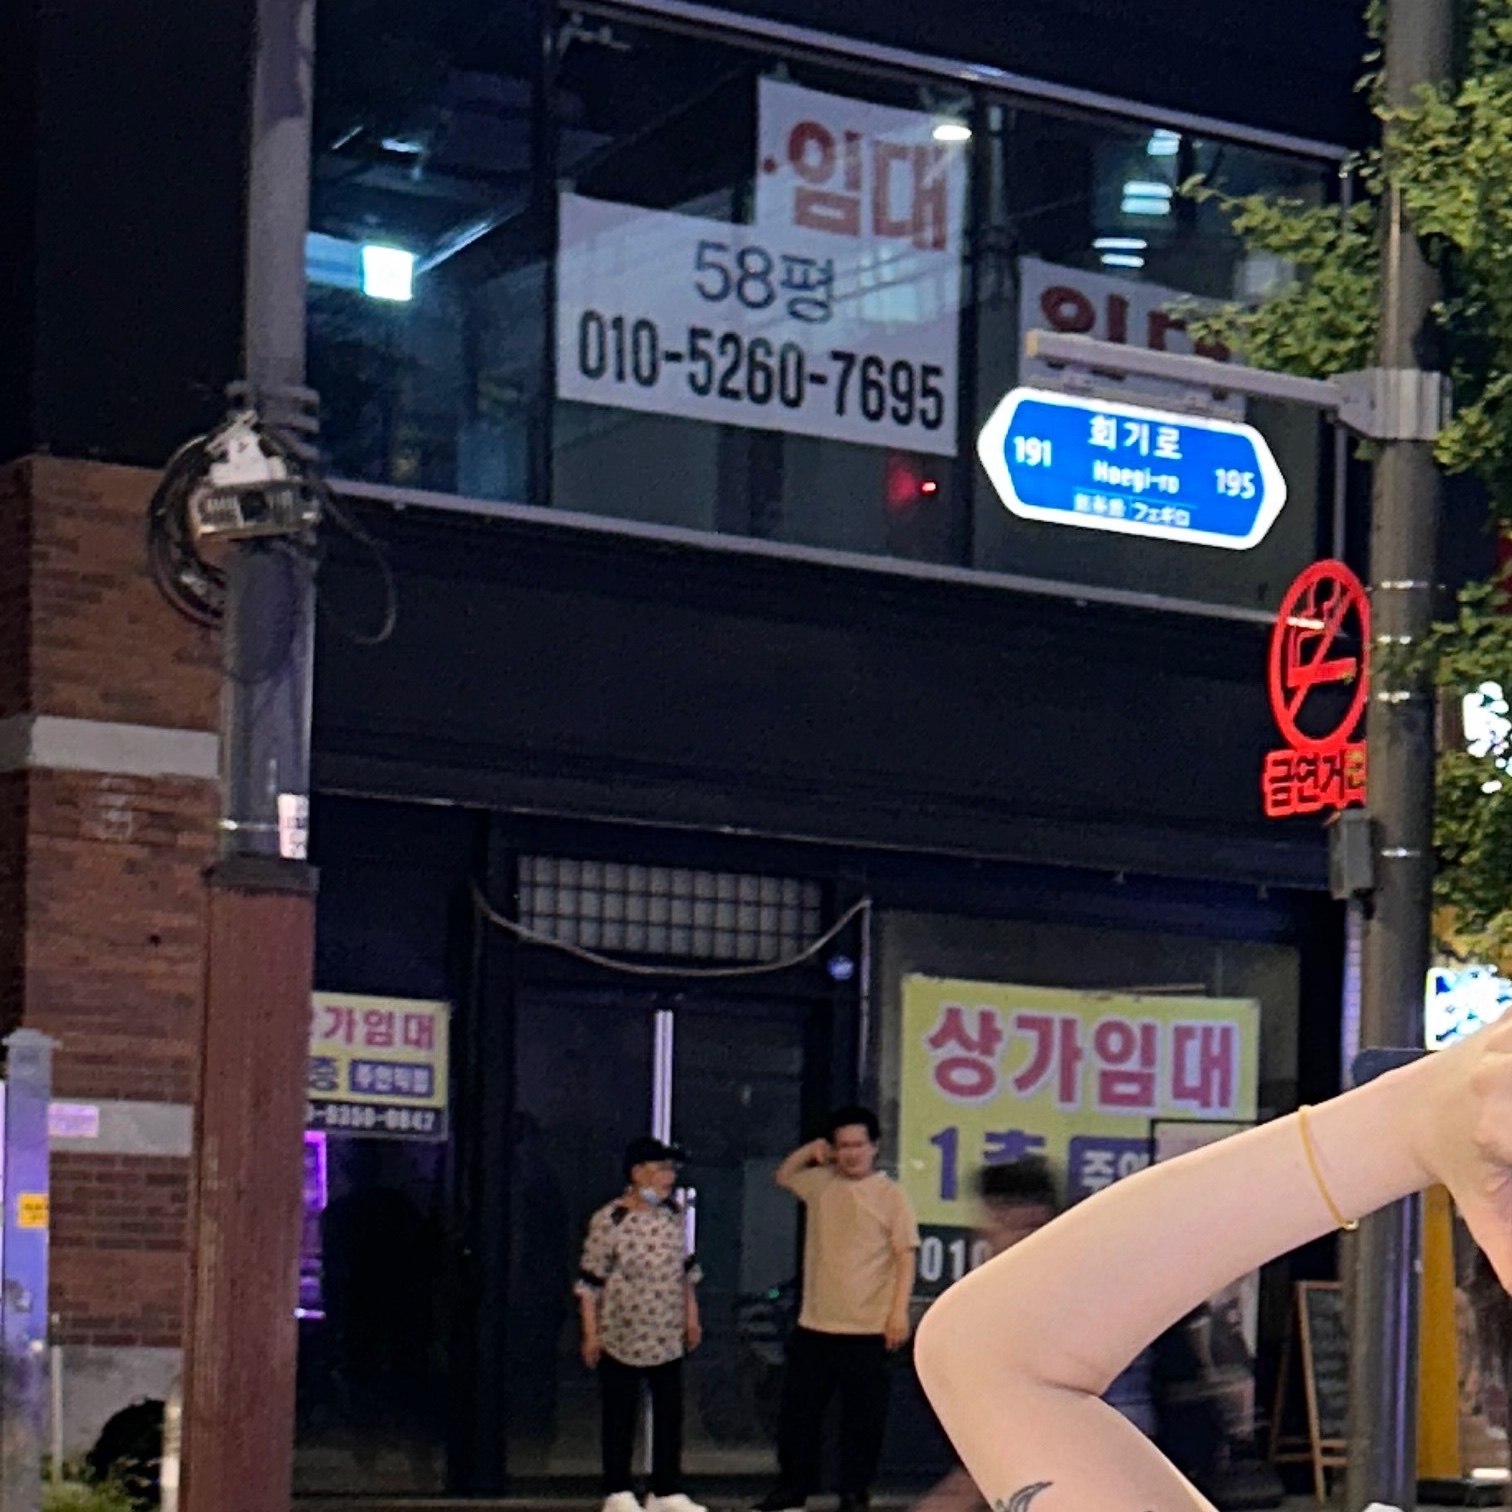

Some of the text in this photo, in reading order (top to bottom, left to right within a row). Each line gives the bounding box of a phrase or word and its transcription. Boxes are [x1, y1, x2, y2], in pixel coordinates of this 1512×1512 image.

[787, 120, 947, 252] 임대
[694, 238, 835, 324] 58평
[578, 309, 944, 431] 010-5260-7695
[1013, 436, 1051, 467] 191
[1087, 415, 1183, 460] 회기로
[1092, 460, 1180, 494] Hoegi-ro
[1214, 468, 1256, 499] 195
[928, 1007, 1237, 1109] 상가임대
